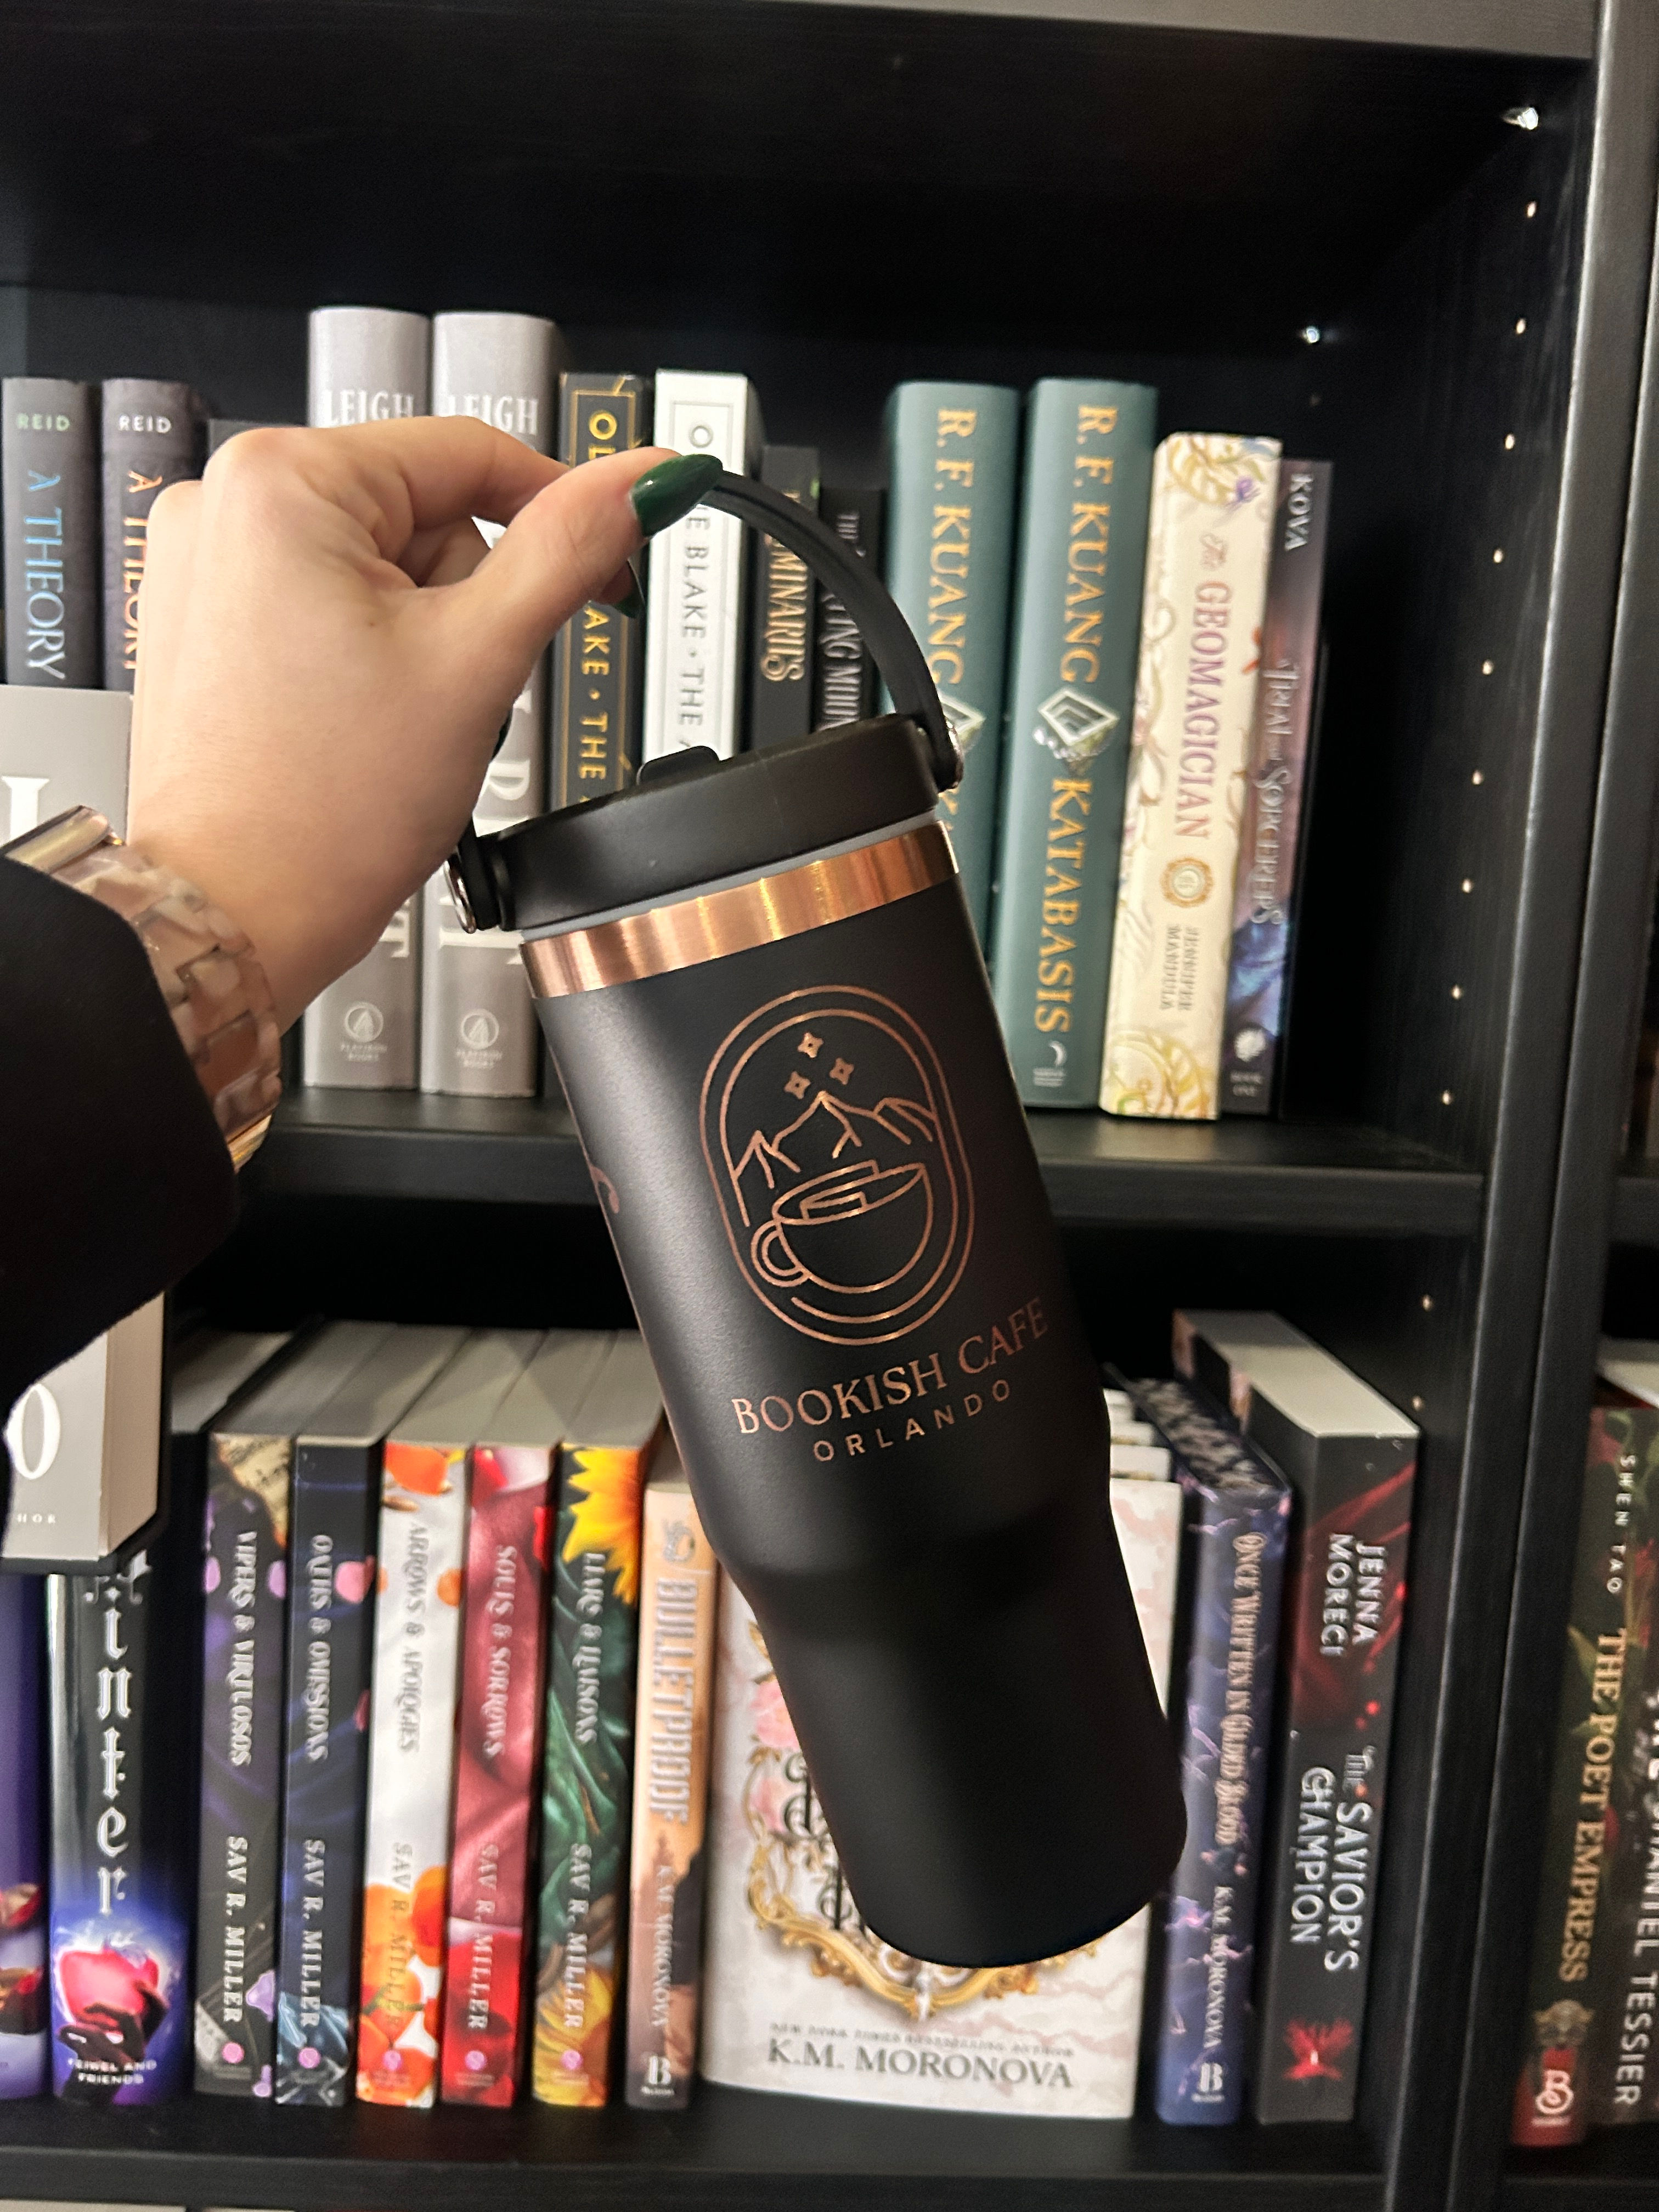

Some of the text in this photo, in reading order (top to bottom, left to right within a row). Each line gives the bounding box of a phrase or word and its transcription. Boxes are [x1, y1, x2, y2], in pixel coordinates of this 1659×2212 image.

[16, 414, 71, 431] REID
[118, 414, 172, 434] REID
[326, 387, 415, 427] LEIGH
[127, 471, 163, 494] A
[1284, 473, 1314, 551] KOVA
[23, 470, 66, 680] A THEORY
[681, 540, 709, 640] BLAKE
[928, 408, 978, 685] R. F. KUANG
[1060, 404, 1118, 684] R. F. KUANG
[761, 533, 808, 681] MINARIES
[579, 606, 611, 781] AKE THE
[679, 668, 706, 727] THE
[1176, 581, 1233, 837] GEOMAGICIAN
[1035, 776, 1091, 1034] KATABASIS
[731, 1297, 1048, 1435] BOOKISH CAFE
[813, 1378, 1012, 1462] ORLANDO
[228, 1531, 257, 1608] VIPERS
[403, 1525, 430, 1613] ARROWS
[1606, 1454, 1637, 1593] SHEN TAO
[1319, 1533, 1355, 1656] MORECI
[1352, 1541, 1387, 1645] JENNA
[227, 1639, 255, 1767] VIRTUOSOS
[303, 1640, 331, 1763] OMISSIONS
[482, 1646, 511, 1757] SORROWS
[650, 1578, 698, 1825] BULLETPROOF
[1289, 1766, 1336, 1943] CHAMPION
[1559, 1627, 1627, 1983] THE POET EMPRESS
[391, 1841, 413, 1890] SAV
[478, 1844, 499, 1891] SAV
[570, 1843, 592, 1892] SAV
[1323, 1802, 1373, 1972] SAVIOR'S
[223, 1836, 248, 2023] SAV R. MILLER
[301, 1839, 325, 2028] SAV R. MILLER
[386, 1934, 409, 2030] MILLER
[468, 1934, 494, 2029] MILLER
[564, 1933, 588, 2029] MILLER
[1204, 1933, 1230, 2049] MORONOVA
[1613, 1971, 1658, 2106] TESSIER
[768, 2038, 1073, 2089] K.M. MORONOVA
